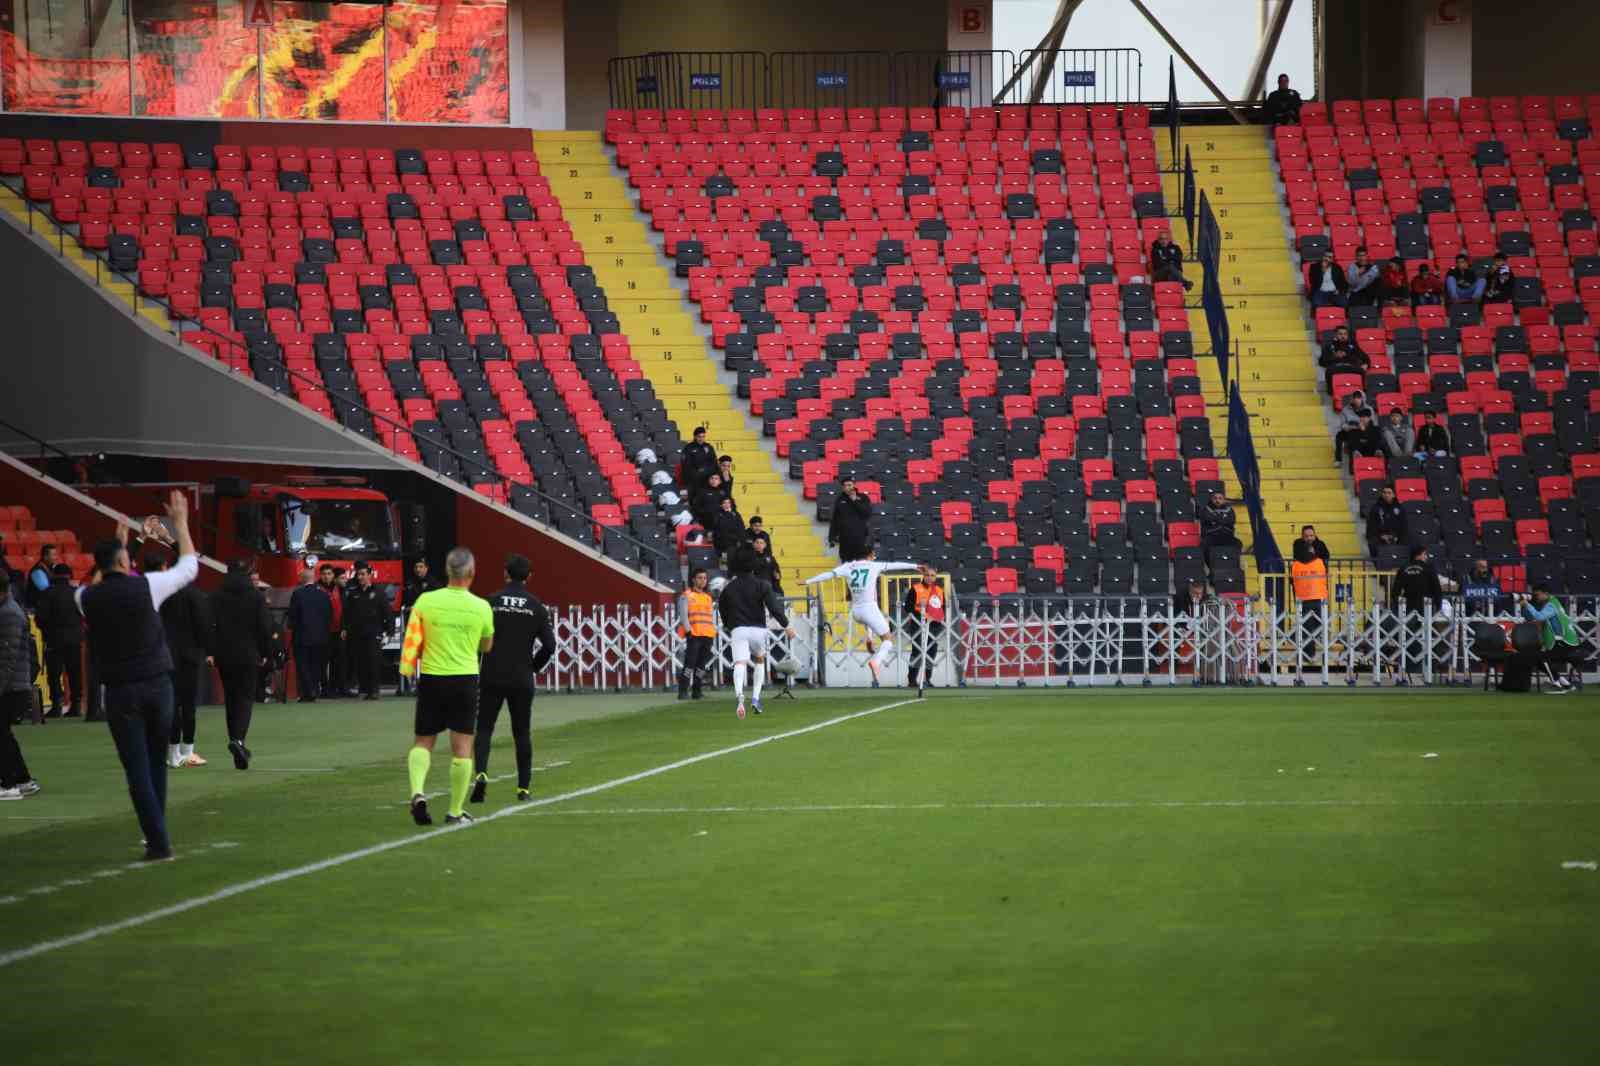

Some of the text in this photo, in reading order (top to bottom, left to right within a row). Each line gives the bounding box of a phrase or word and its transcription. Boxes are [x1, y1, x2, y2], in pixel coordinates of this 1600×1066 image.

[250, 0, 272, 23] A
[1438, 0, 1457, 21] C
[962, 9, 982, 31] B
[584, 191, 592, 199] 22
[640, 304, 648, 313] 17
[652, 328, 660, 336] 16
[664, 352, 672, 360] 15
[688, 401, 696, 410] 13
[850, 568, 869, 587] 27
[501, 596, 527, 607] TFF
